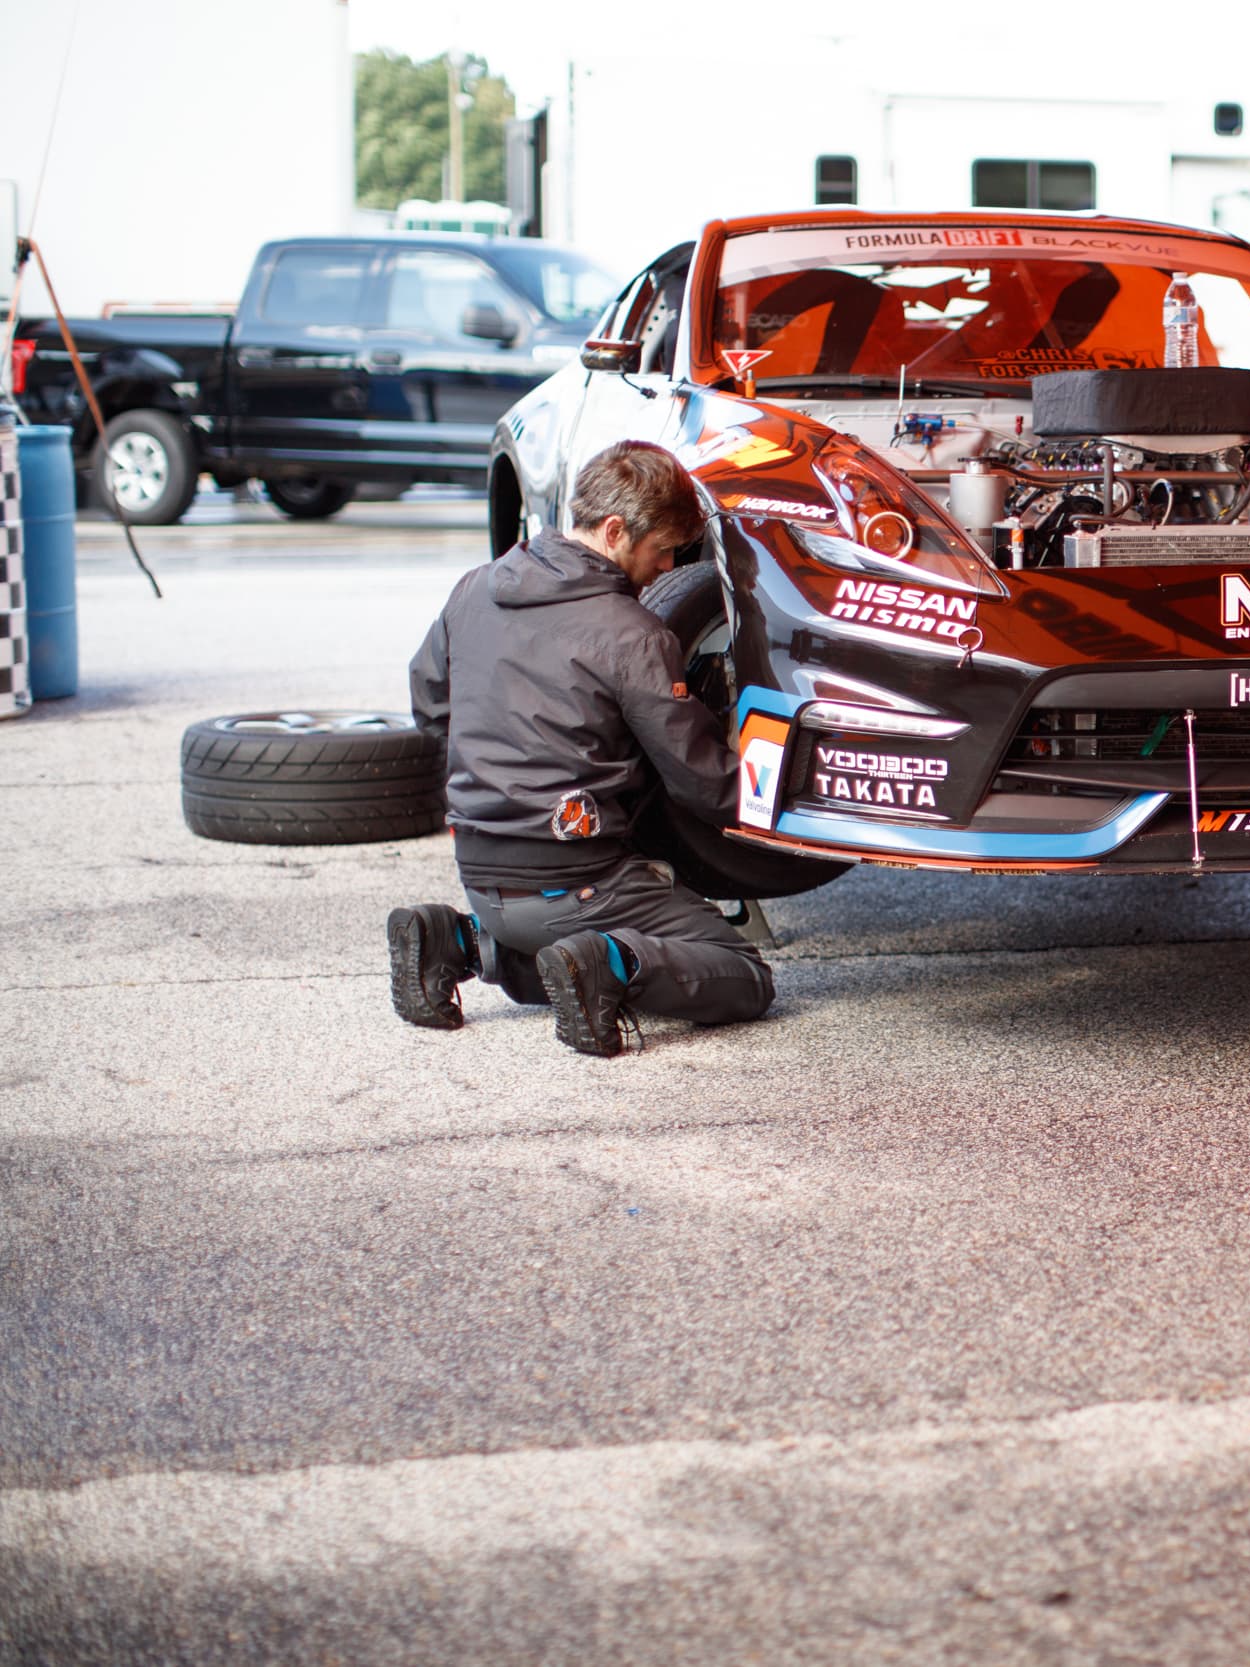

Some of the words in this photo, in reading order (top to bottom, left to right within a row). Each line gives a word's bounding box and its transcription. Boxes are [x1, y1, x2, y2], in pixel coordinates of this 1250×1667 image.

[845, 231, 943, 249] FORMULA
[946, 229, 1022, 247] DRIFT
[1031, 235, 1181, 256] BLACKVUE
[835, 579, 977, 620] NISSAN
[816, 773, 936, 807] TAKATA
[746, 798, 772, 816] Valvoline
